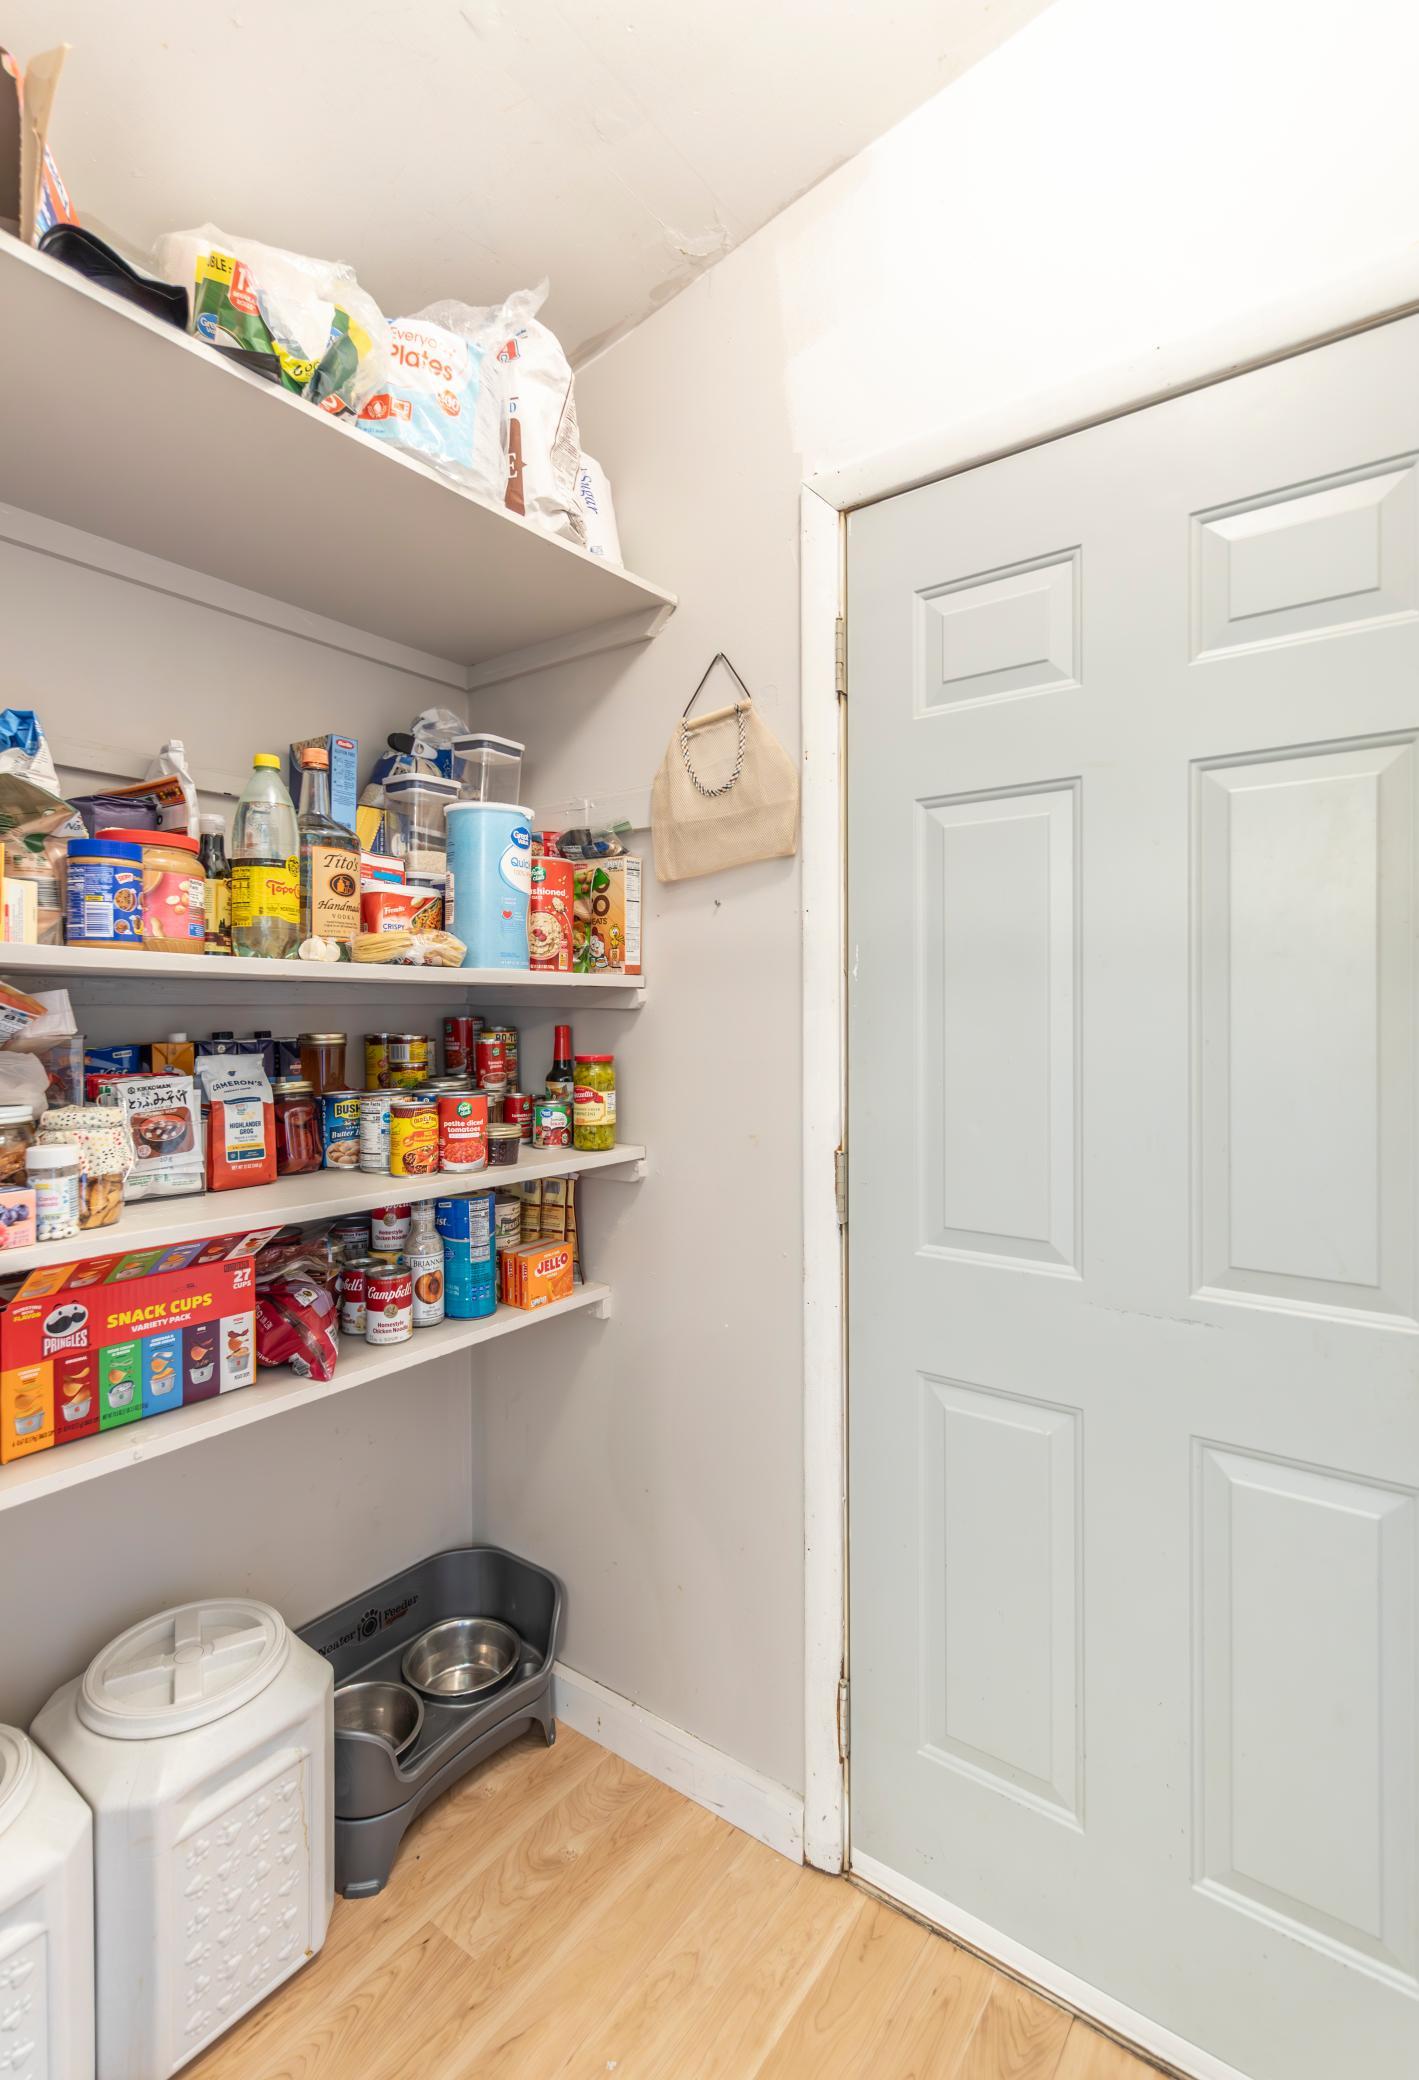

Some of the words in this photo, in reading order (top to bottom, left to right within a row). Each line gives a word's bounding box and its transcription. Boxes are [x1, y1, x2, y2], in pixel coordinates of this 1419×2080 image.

[325, 854, 359, 872] Tito's
[511, 856, 530, 869] Quic
[318, 899, 359, 917] Handmad
[229, 1120, 262, 1129] HIGHLANDER
[443, 1120, 466, 1128] petite
[331, 1130, 354, 1140] Butter
[233, 1267, 252, 1283] 27
[232, 1279, 251, 1290] CUPS
[368, 1280, 412, 1302] Campbell's
[106, 1302, 167, 1328] SNACK
[169, 1292, 213, 1315] CUPS
[130, 1318, 169, 1332] VARIETY
[168, 1312, 192, 1324] PACK
[377, 1319, 404, 1328] Homestyle
[372, 1327, 392, 1335] Chicken
[43, 1328, 88, 1357] PRINGLES
[383, 1595, 419, 1619] Feeder
